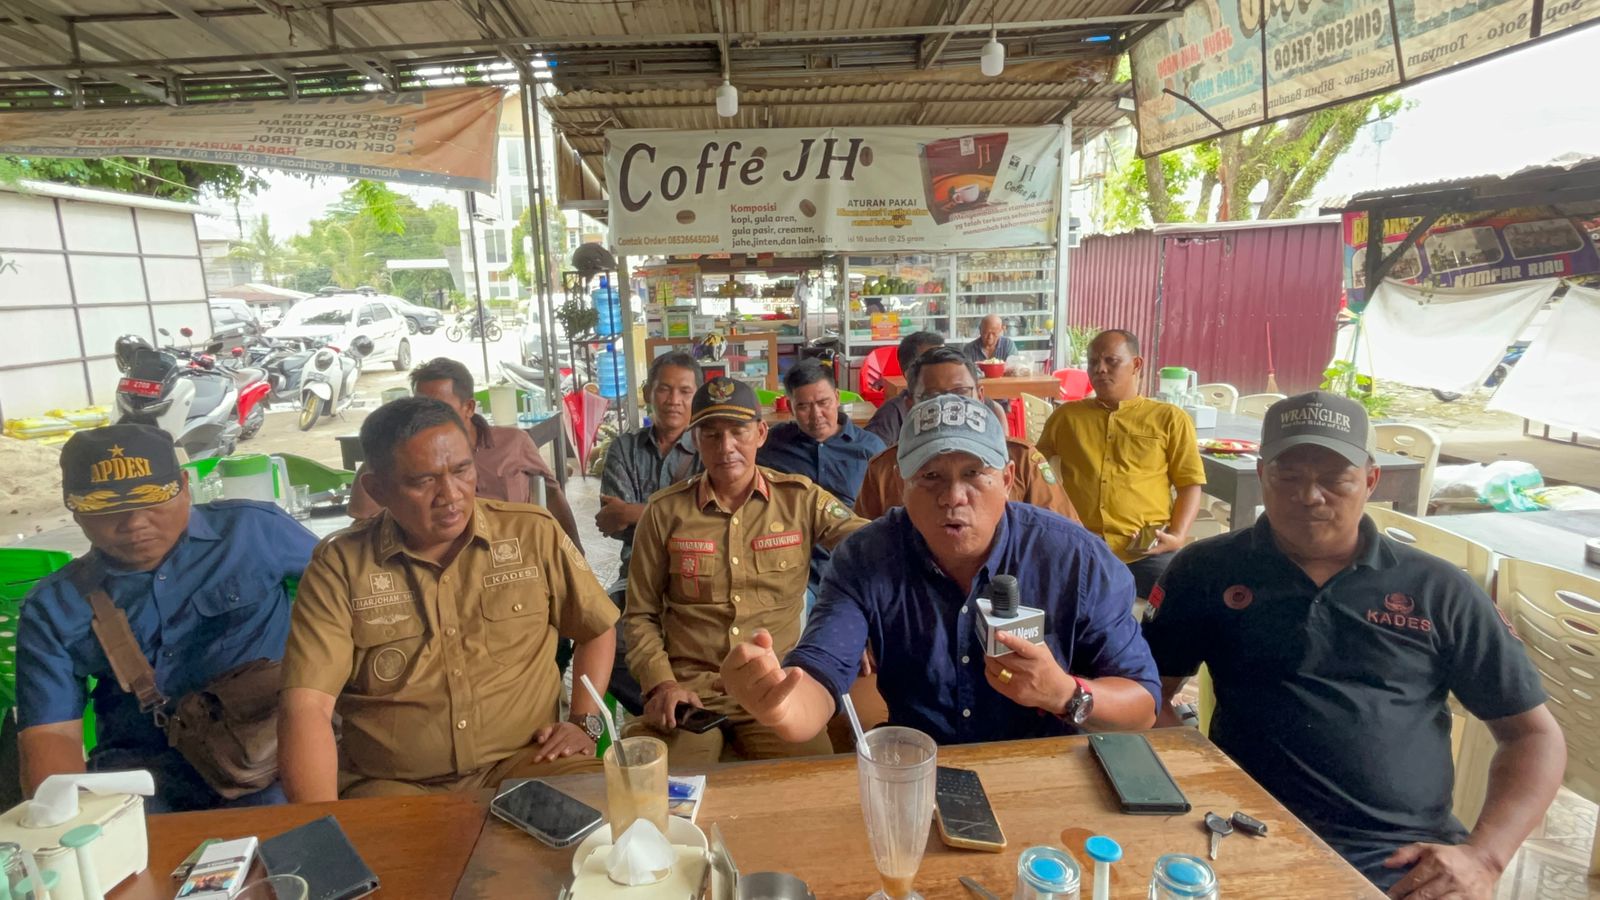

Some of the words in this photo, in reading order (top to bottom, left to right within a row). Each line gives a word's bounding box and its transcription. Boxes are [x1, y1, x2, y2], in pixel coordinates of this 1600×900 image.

[783, 138, 864, 182] JH
[730, 203, 777, 214] Komposisi
[847, 199, 886, 208] ATURAN
[889, 199, 917, 207] PAKAI
[731, 215, 753, 226] kopi,
[755, 215, 773, 225] gula
[775, 215, 797, 225] aren,
[732, 226, 751, 237] gula
[752, 225, 776, 237] pasir,
[777, 225, 815, 235] creamer,
[798, 235, 833, 245] lain-lain
[864, 234, 887, 243] sachet
[897, 235, 906, 243] 25
[907, 236, 926, 245] gram
[1528, 259, 1564, 276] RIAU
[913, 401, 987, 435] 1985
[1280, 408, 1351, 429] WRANGLER
[91, 457, 152, 482] APDESI
[492, 569, 533, 585] KADES
[1367, 609, 1432, 632] KADES
[1017, 626, 1039, 640] News
